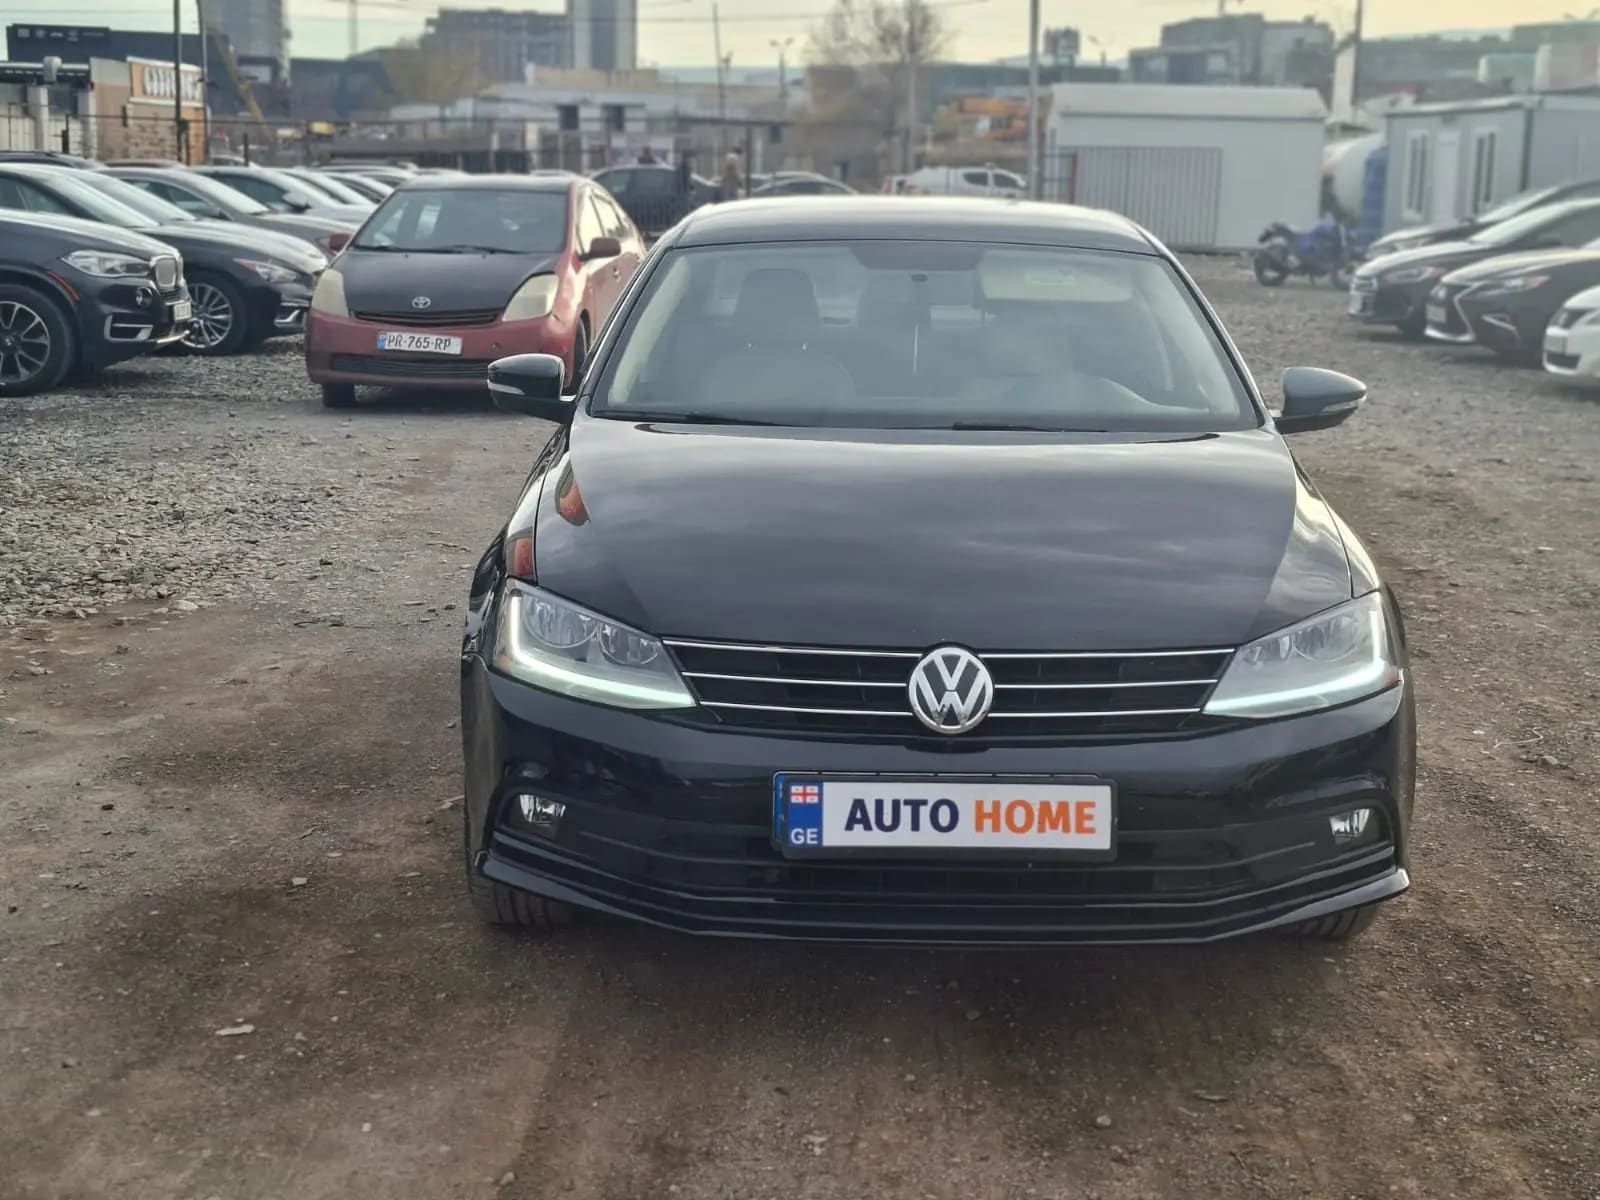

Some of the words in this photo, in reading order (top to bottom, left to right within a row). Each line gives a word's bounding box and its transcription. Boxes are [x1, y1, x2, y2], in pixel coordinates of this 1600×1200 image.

[387, 334, 452, 351] PR-765-RP
[844, 798, 959, 833] AUTO
[974, 799, 1097, 834] HOME
[790, 828, 819, 845] GE
